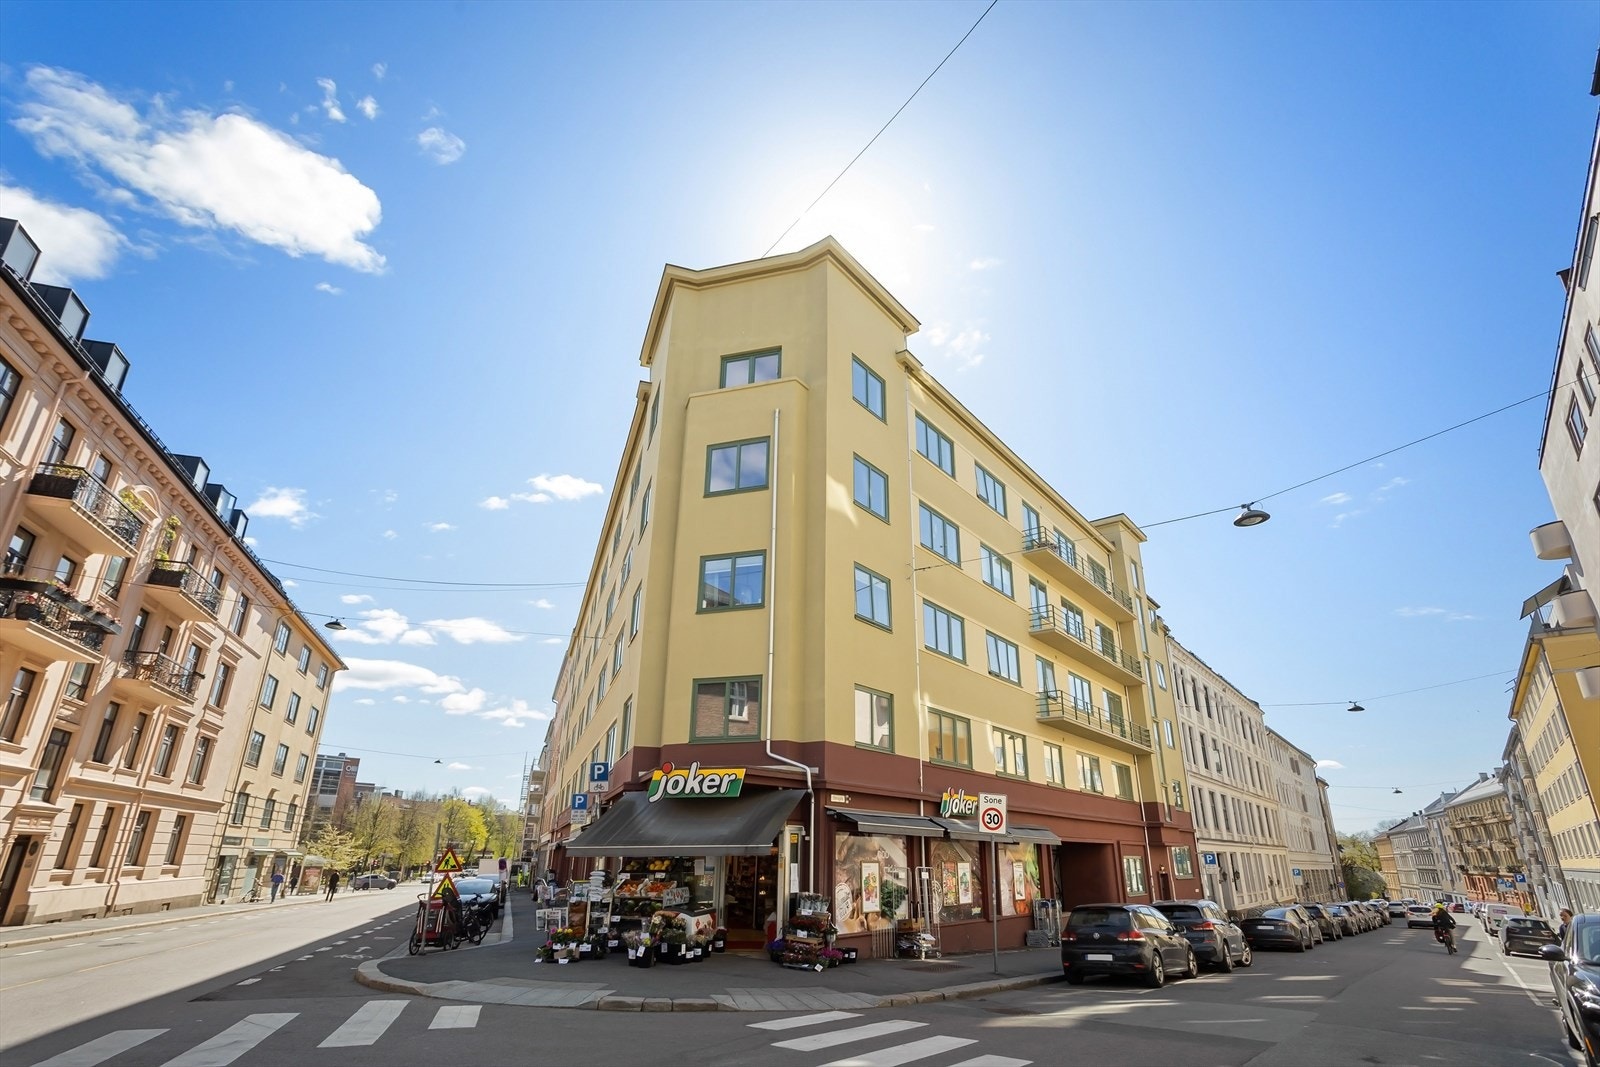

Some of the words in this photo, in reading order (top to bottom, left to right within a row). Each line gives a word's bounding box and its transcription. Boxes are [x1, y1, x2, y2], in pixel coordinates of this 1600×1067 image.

[594, 764, 605, 780] P
[648, 761, 737, 803] joker
[575, 795, 585, 808] P
[943, 787, 978, 819] joker
[983, 795, 1003, 805] Sone
[986, 812, 1000, 826] 30
[1206, 854, 1214, 864] P
[1516, 874, 1523, 882] P
